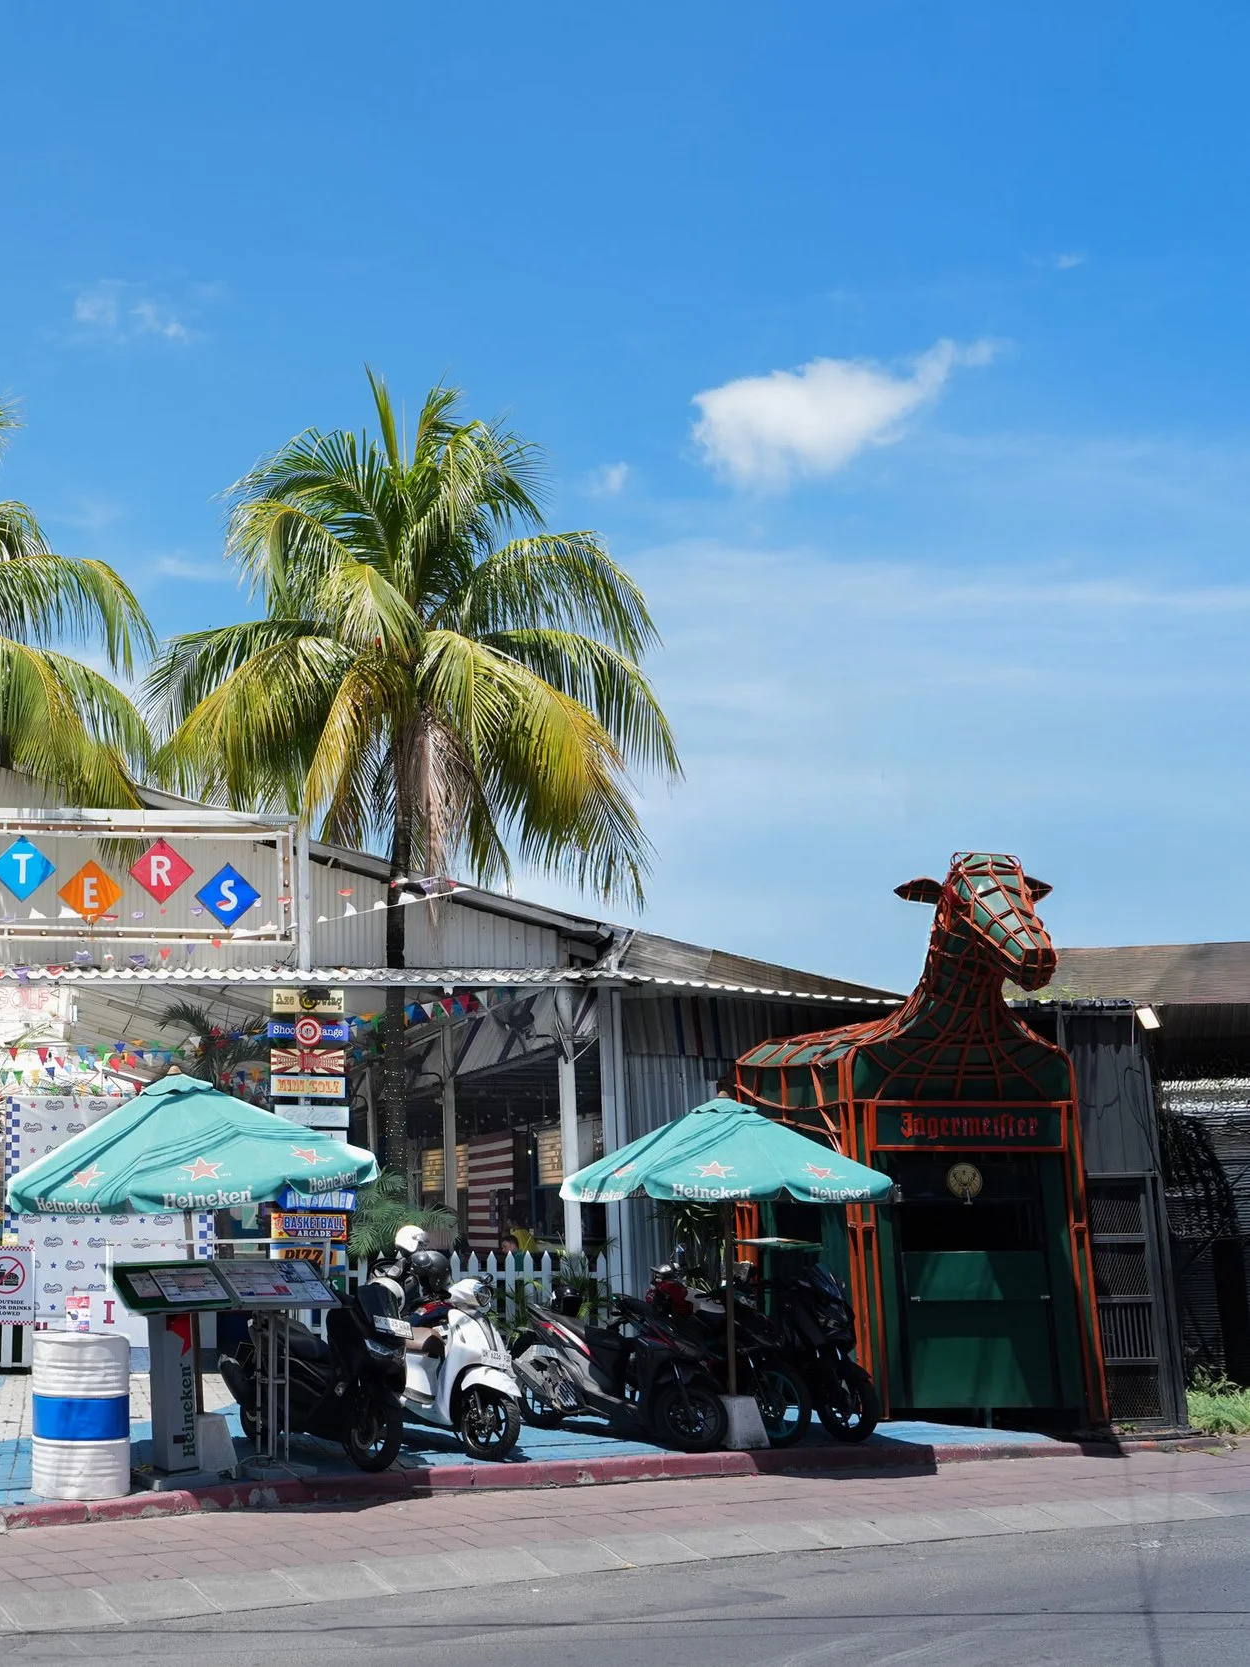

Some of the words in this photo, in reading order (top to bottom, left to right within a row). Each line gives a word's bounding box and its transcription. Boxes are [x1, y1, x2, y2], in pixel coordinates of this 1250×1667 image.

[320, 1028, 344, 1038] ange
[276, 1078, 305, 1092] MINI
[309, 1080, 340, 1093] GOLF
[308, 1170, 358, 1193] Heineken
[162, 1188, 253, 1210] Heineken
[580, 1187, 625, 1201] Heineken
[671, 1183, 751, 1199] Heineken
[809, 1186, 871, 1201] Heineken
[34, 1196, 102, 1214] Heineken
[283, 1215, 345, 1231] BASKETBALL
[297, 1229, 332, 1237] ARCADE
[180, 1364, 196, 1458] Heineken
